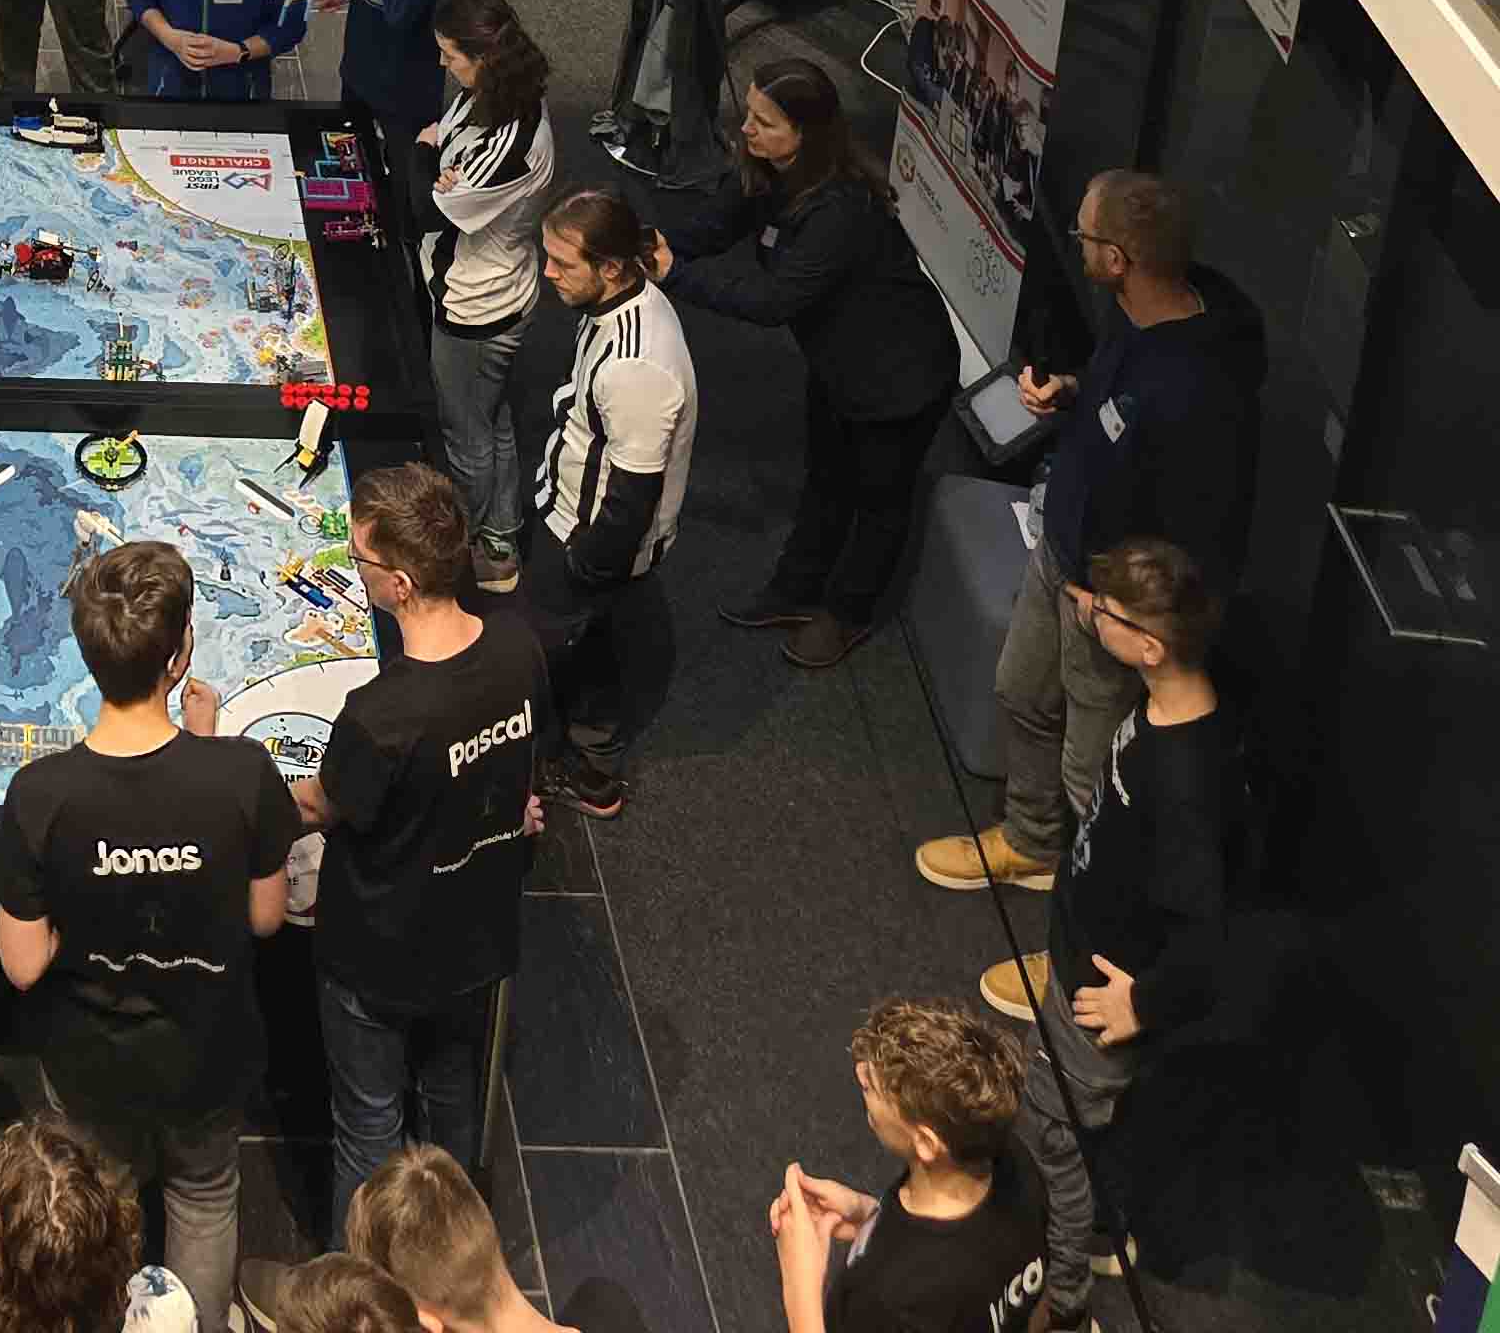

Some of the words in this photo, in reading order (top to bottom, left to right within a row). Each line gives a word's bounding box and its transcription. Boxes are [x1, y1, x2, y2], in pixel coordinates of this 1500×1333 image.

[172, 168, 219, 176] LEAGUE
[178, 156, 263, 167] CHALLENGE
[449, 699, 532, 778] Pascal
[92, 840, 203, 876] Jonas
